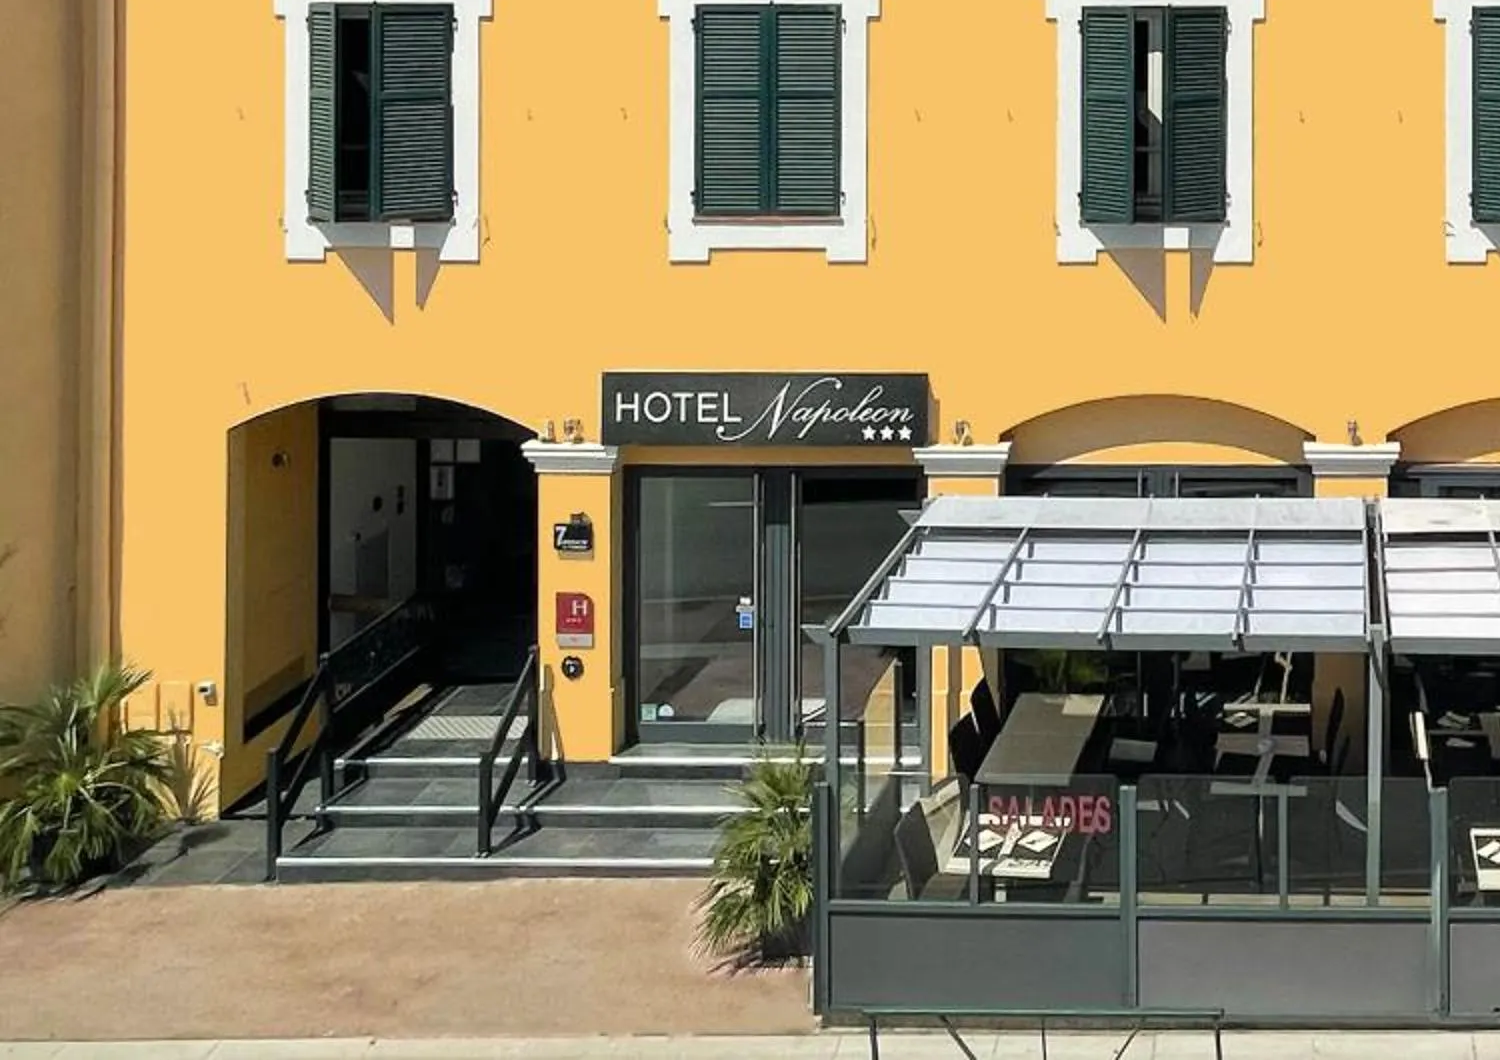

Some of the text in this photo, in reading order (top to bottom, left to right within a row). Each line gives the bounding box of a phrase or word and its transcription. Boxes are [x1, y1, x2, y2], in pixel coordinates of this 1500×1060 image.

[615, 377, 915, 440] HOTEL Napoleon
[572, 599, 588, 616] H
[989, 795, 1112, 834] SALADES
